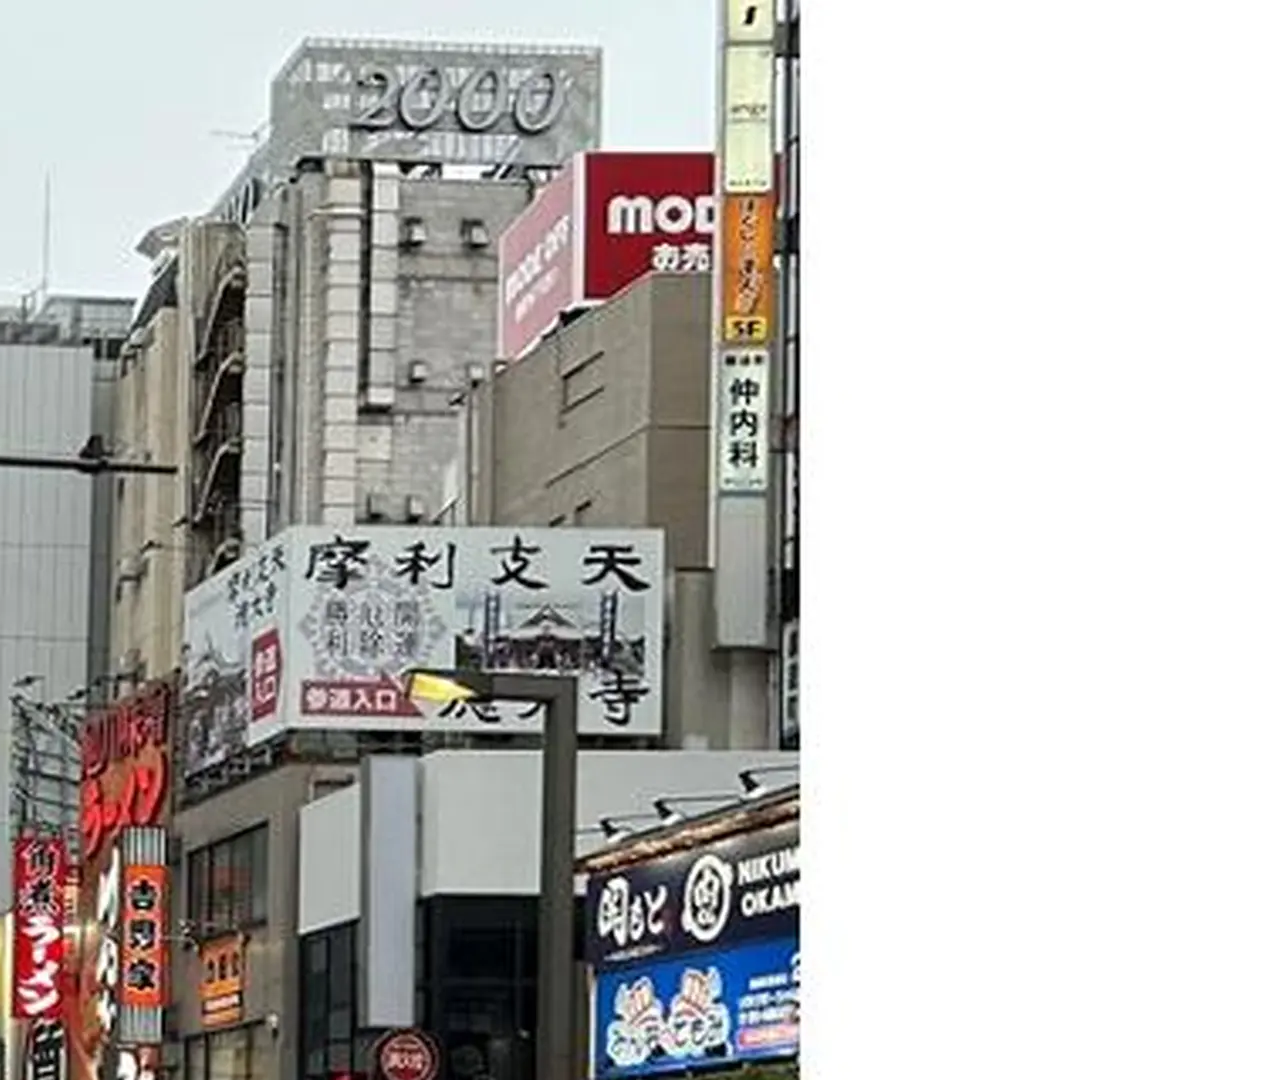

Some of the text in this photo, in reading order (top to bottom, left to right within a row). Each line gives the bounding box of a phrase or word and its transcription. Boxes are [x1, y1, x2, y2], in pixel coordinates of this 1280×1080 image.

[348, 70, 567, 132] 2000
[728, 377, 760, 469] 仲内科
[305, 535, 652, 592] 摩利支天
